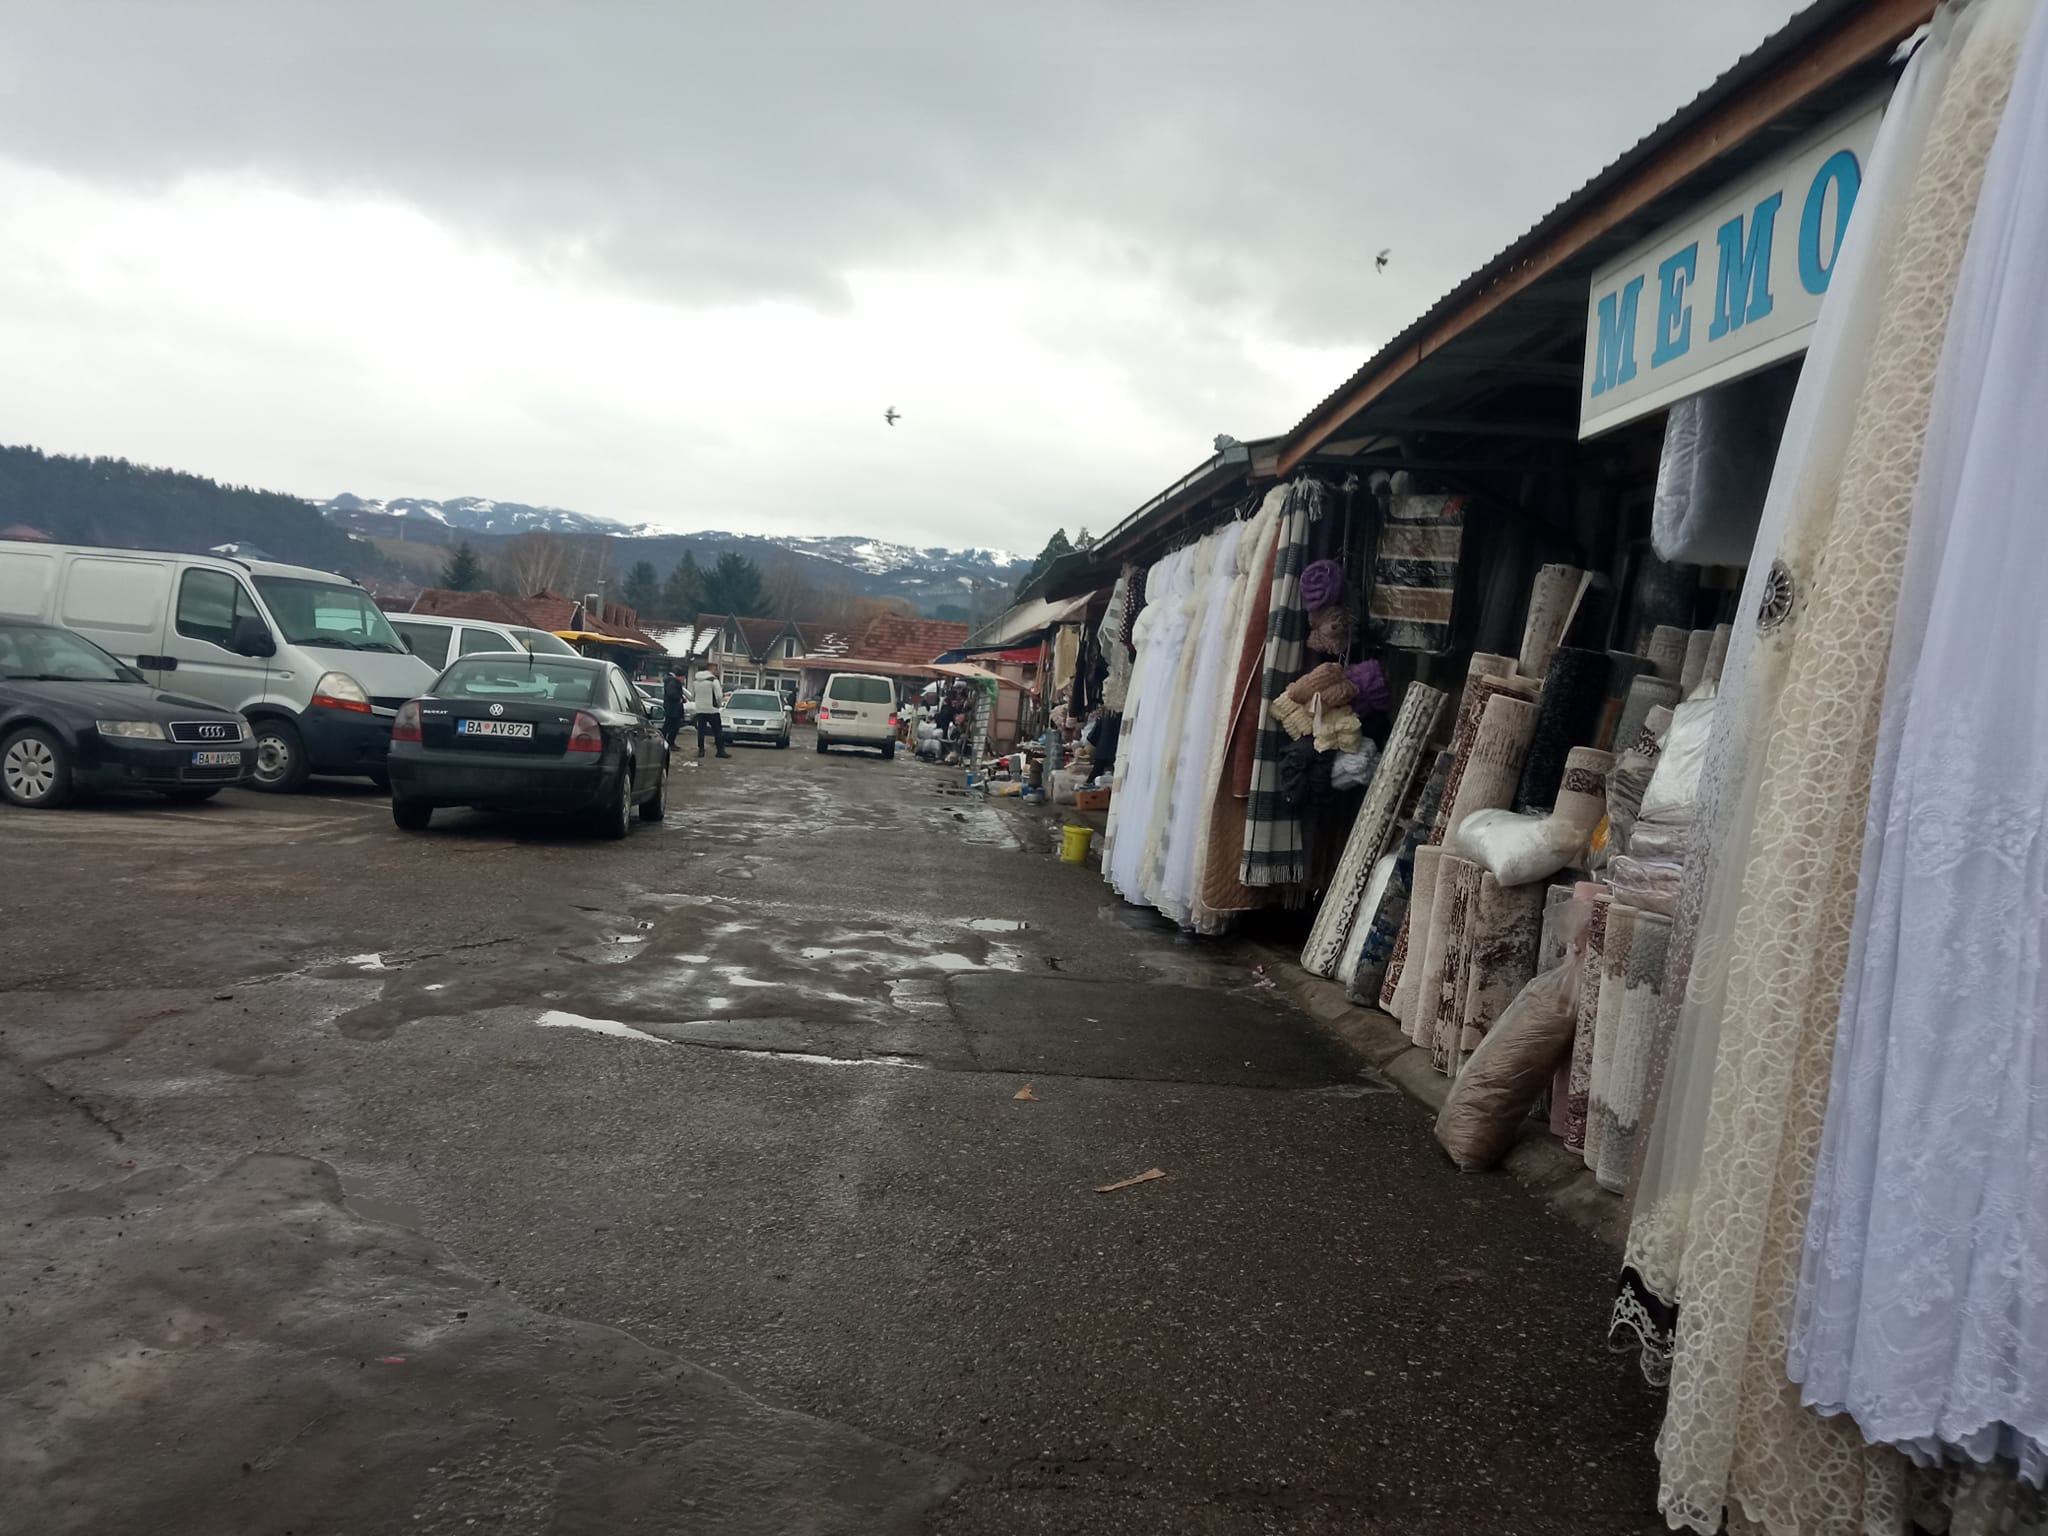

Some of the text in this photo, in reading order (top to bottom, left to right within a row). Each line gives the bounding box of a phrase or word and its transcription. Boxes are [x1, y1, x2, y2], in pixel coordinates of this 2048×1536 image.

[1591, 149, 1863, 399] MEMO
[467, 721, 531, 737] BA AV873
[199, 753, 210, 765] BA
